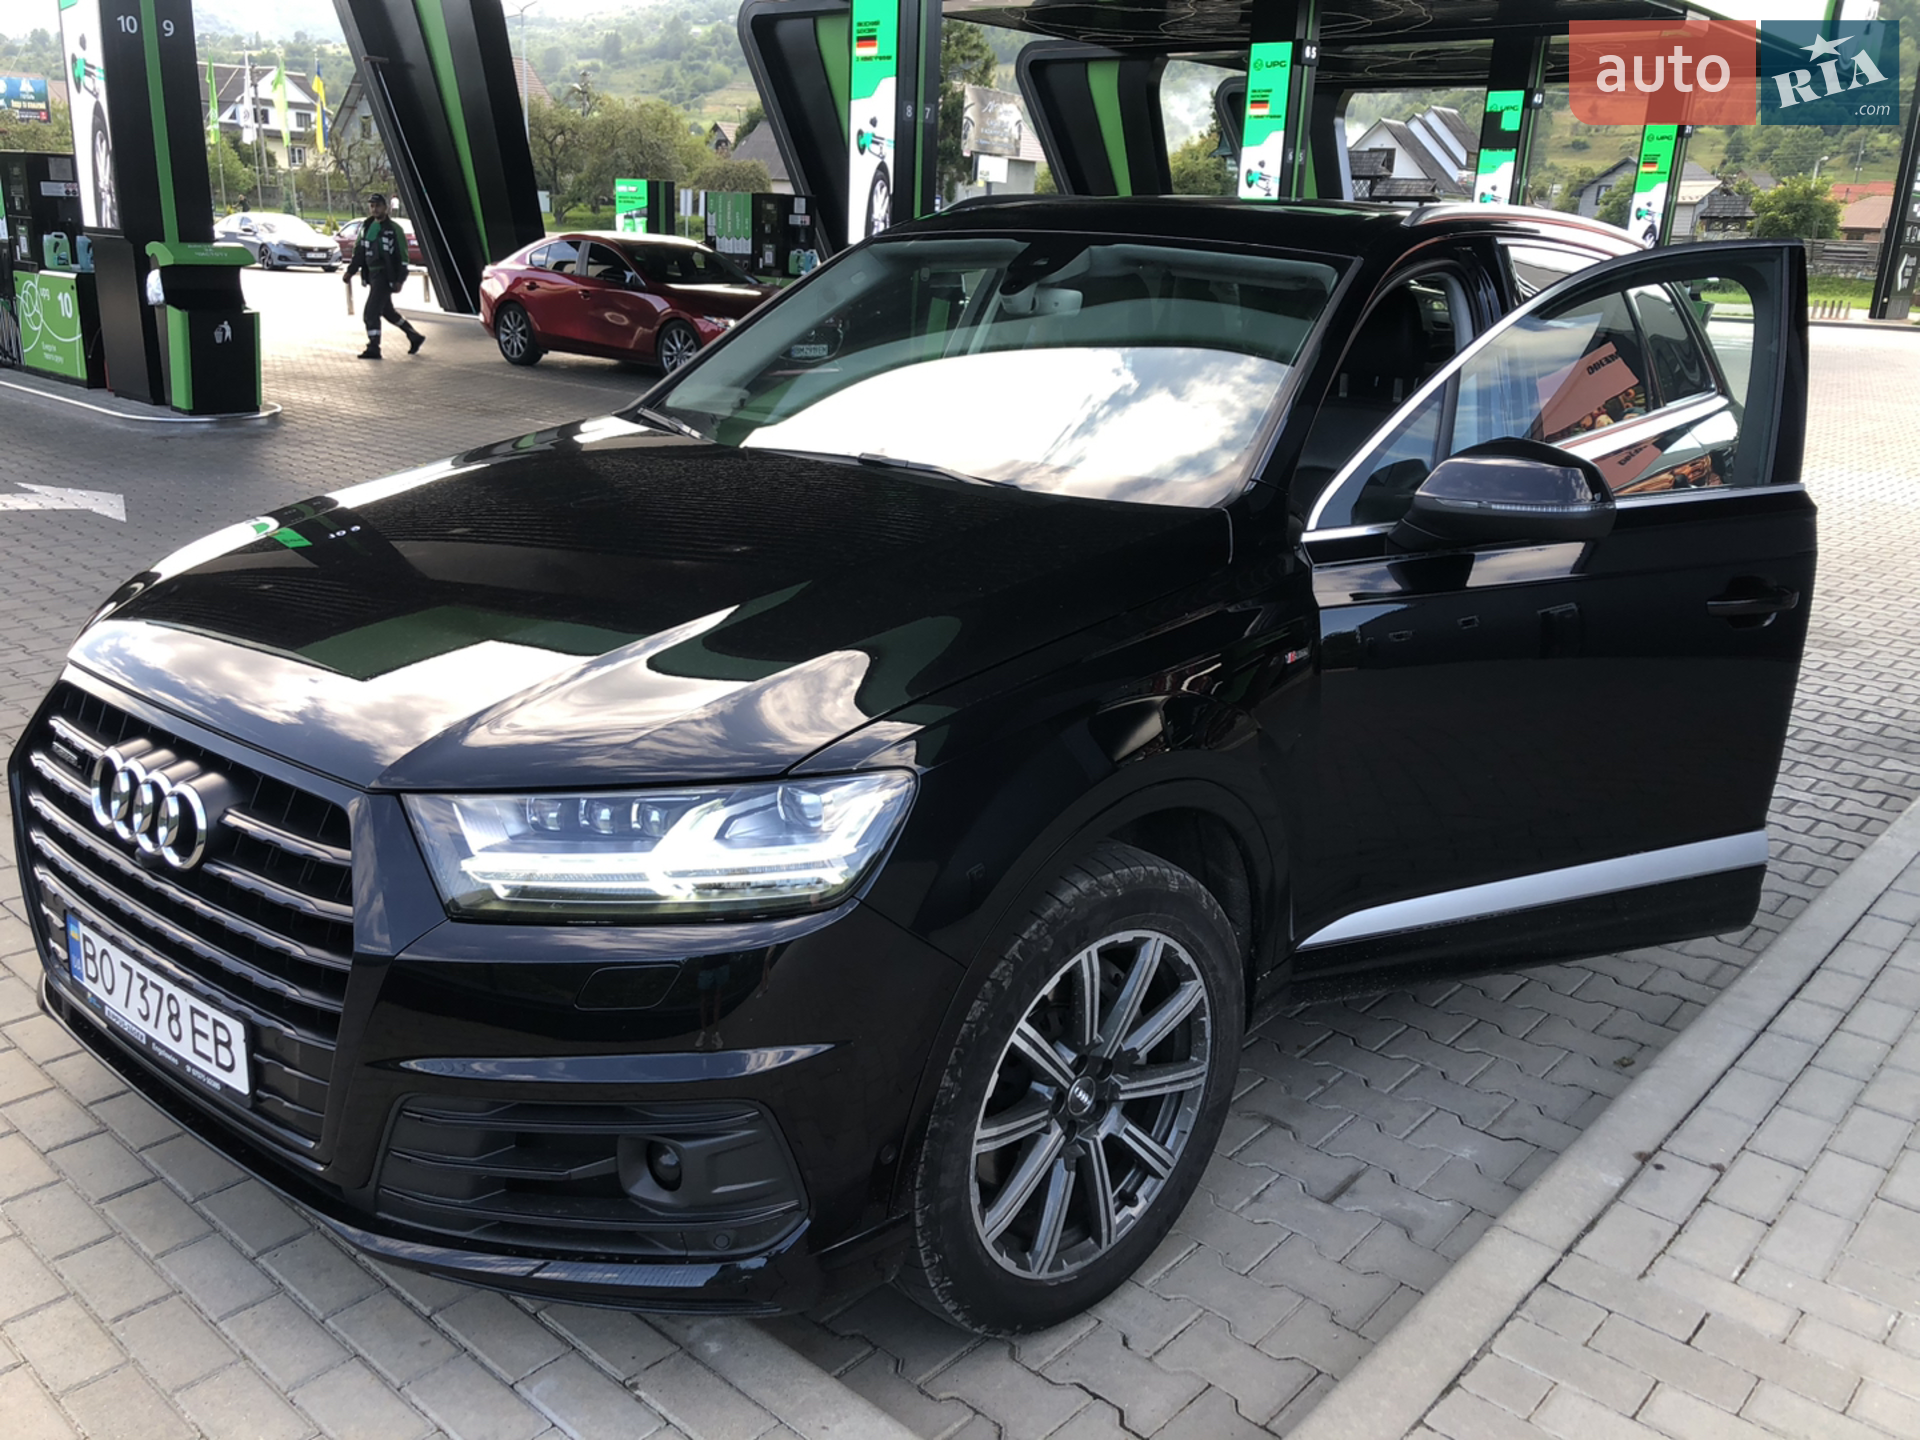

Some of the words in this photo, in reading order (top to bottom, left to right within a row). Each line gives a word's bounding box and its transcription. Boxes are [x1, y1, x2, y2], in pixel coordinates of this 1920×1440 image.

[116, 14, 139, 34] 10
[162, 19, 175, 37] 9
[1265, 60, 1287, 69] UPG
[906, 104, 913, 118] 8
[925, 107, 931, 120] 7
[57, 292, 73, 319] 10
[82, 932, 116, 996] BO
[120, 960, 183, 1043] 7378
[189, 1004, 236, 1074] EB
